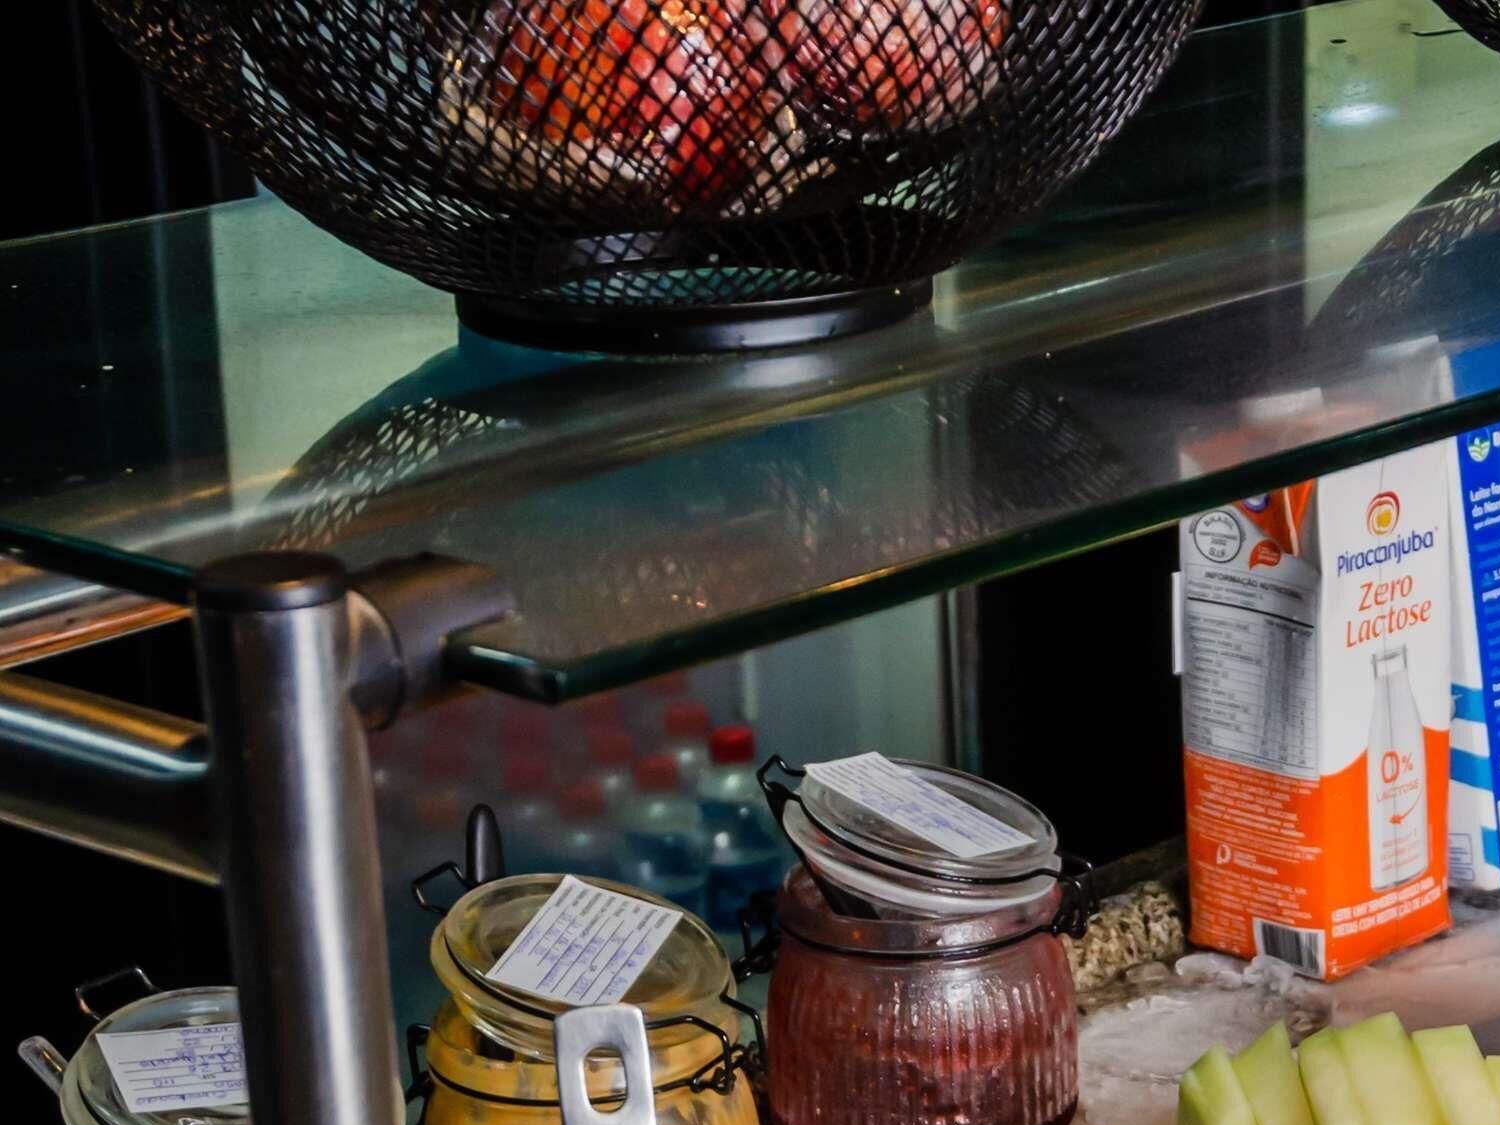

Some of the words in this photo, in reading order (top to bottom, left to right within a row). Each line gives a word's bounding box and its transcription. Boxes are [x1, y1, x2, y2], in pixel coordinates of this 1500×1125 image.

[1470, 485, 1490, 502] Leite
[1337, 531, 1434, 577] Piracanjuba
[1358, 575, 1413, 612] Zero
[1346, 600, 1432, 648] Lactose
